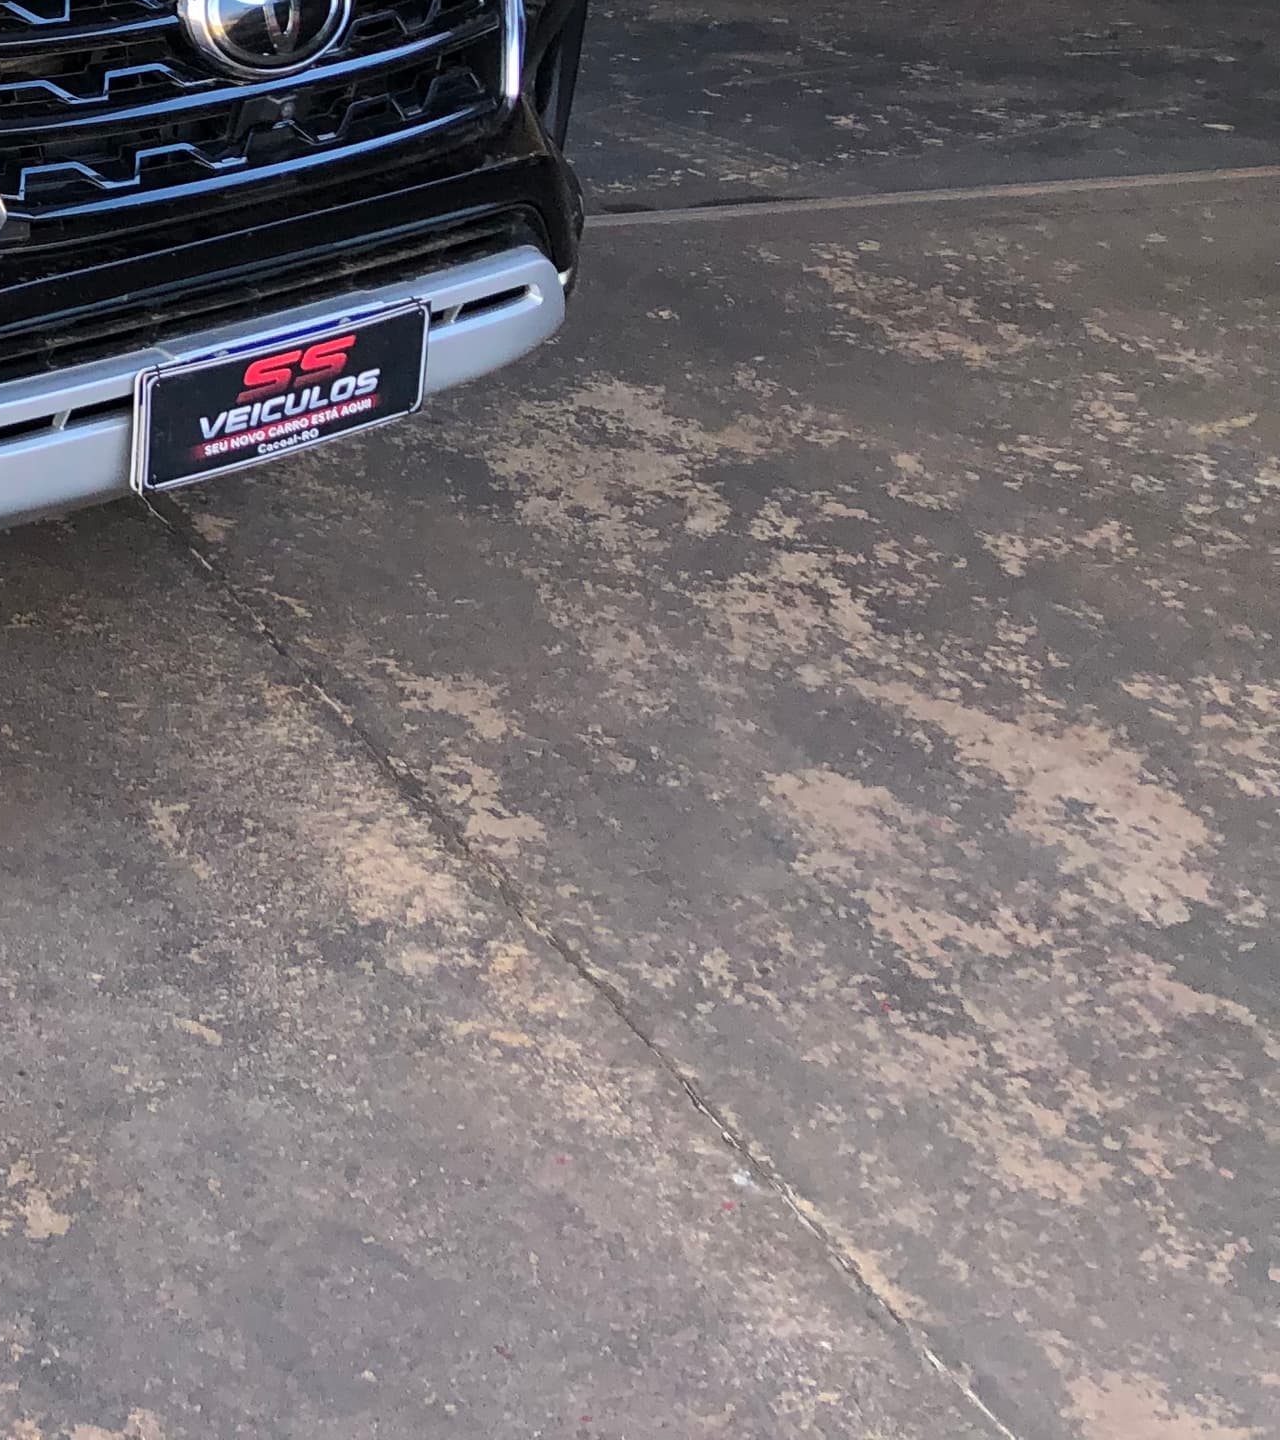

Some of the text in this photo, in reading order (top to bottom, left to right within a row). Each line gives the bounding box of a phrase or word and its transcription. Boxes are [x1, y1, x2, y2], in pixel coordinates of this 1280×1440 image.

[199, 367, 381, 439] VEICULOS
[236, 334, 357, 404] SS
[204, 440, 228, 457] SEU
[230, 431, 266, 449] NOVO
[268, 417, 309, 438] CARRO
[311, 406, 339, 426] ESTÁ
